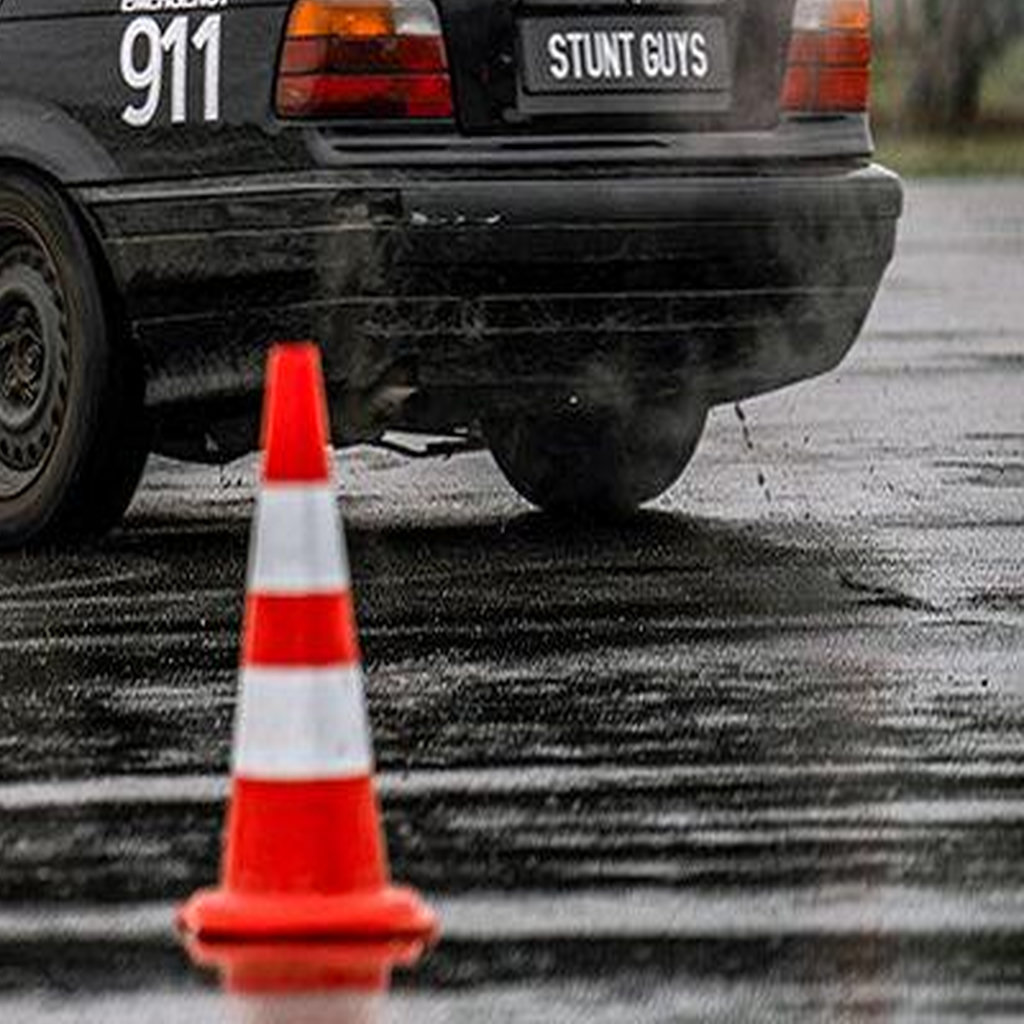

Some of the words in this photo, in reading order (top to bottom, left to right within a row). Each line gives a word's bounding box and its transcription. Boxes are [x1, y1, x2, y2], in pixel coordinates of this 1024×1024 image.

[120, 14, 222, 126] 911
[547, 32, 635, 78] STUNT
[642, 32, 708, 77] GUYS
